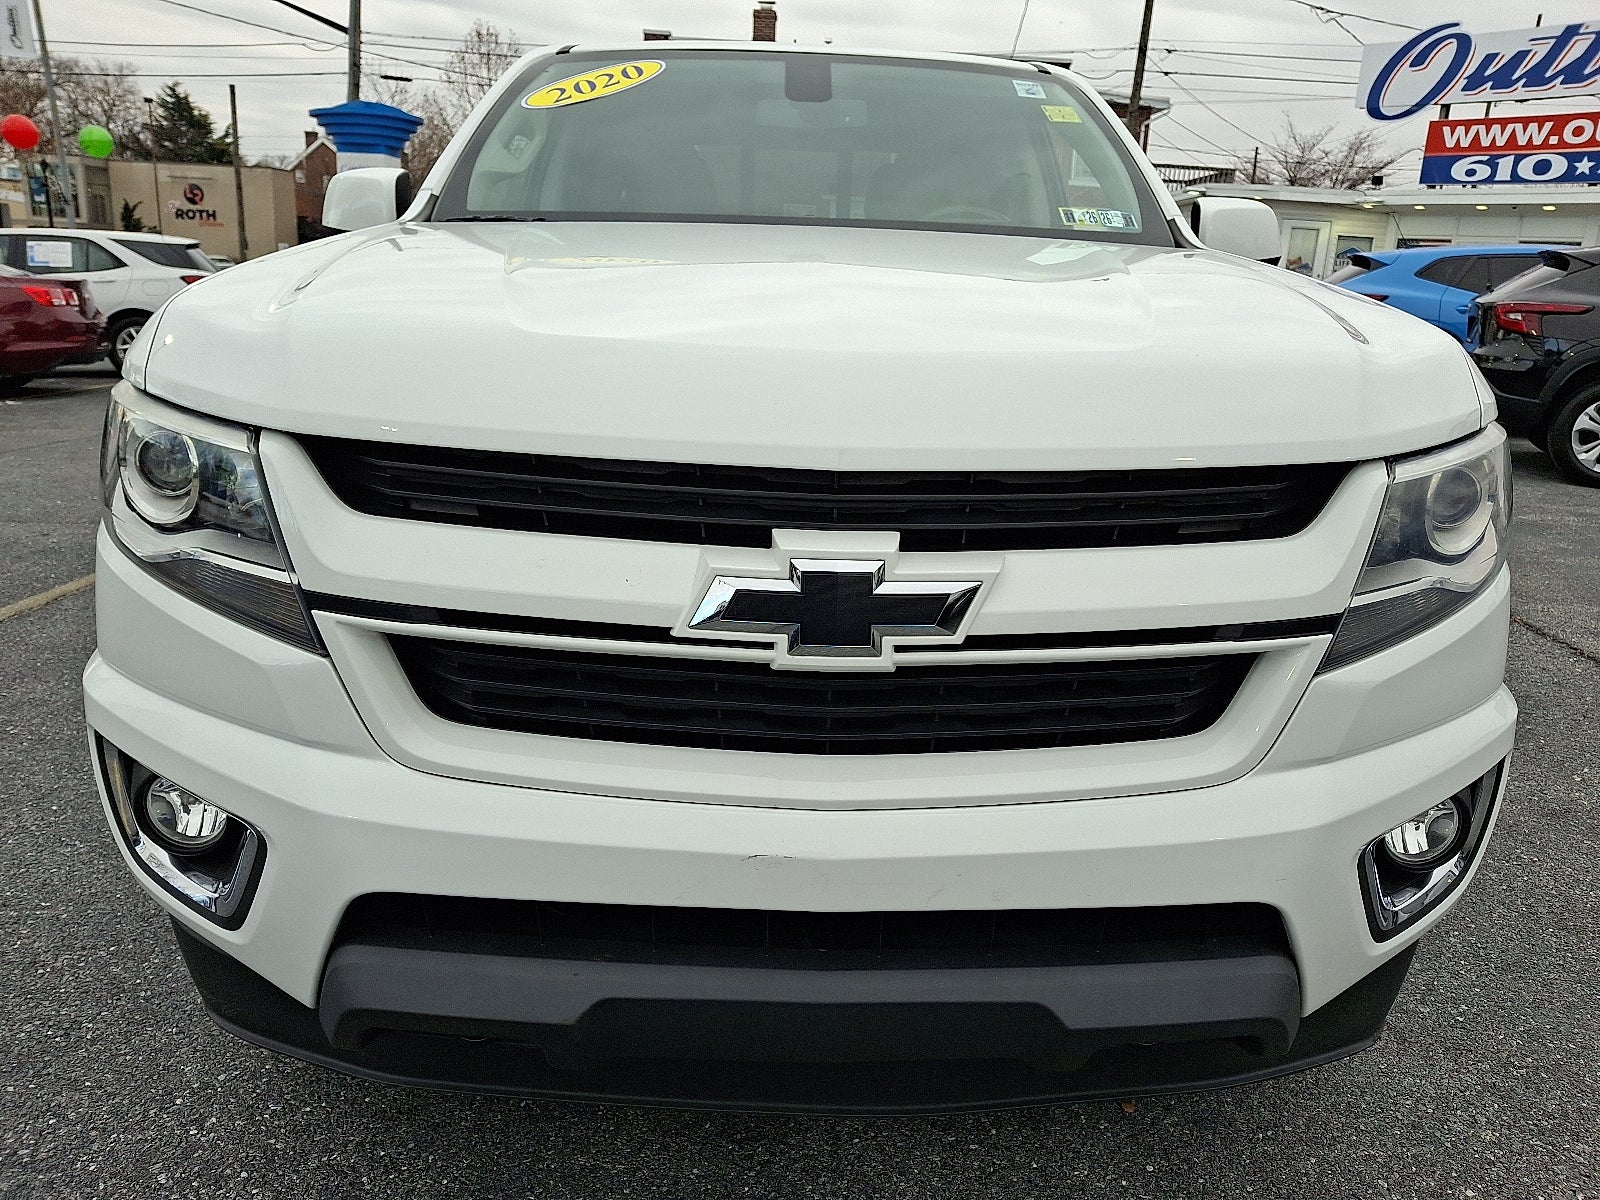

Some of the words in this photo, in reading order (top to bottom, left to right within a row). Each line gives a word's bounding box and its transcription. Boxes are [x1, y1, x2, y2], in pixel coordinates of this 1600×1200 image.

[545, 65, 644, 104] 2020
[1450, 153, 1569, 182] 610
[175, 208, 217, 221] ROTH
[1087, 210, 1099, 224] 26
[1100, 212, 1113, 225] 26
